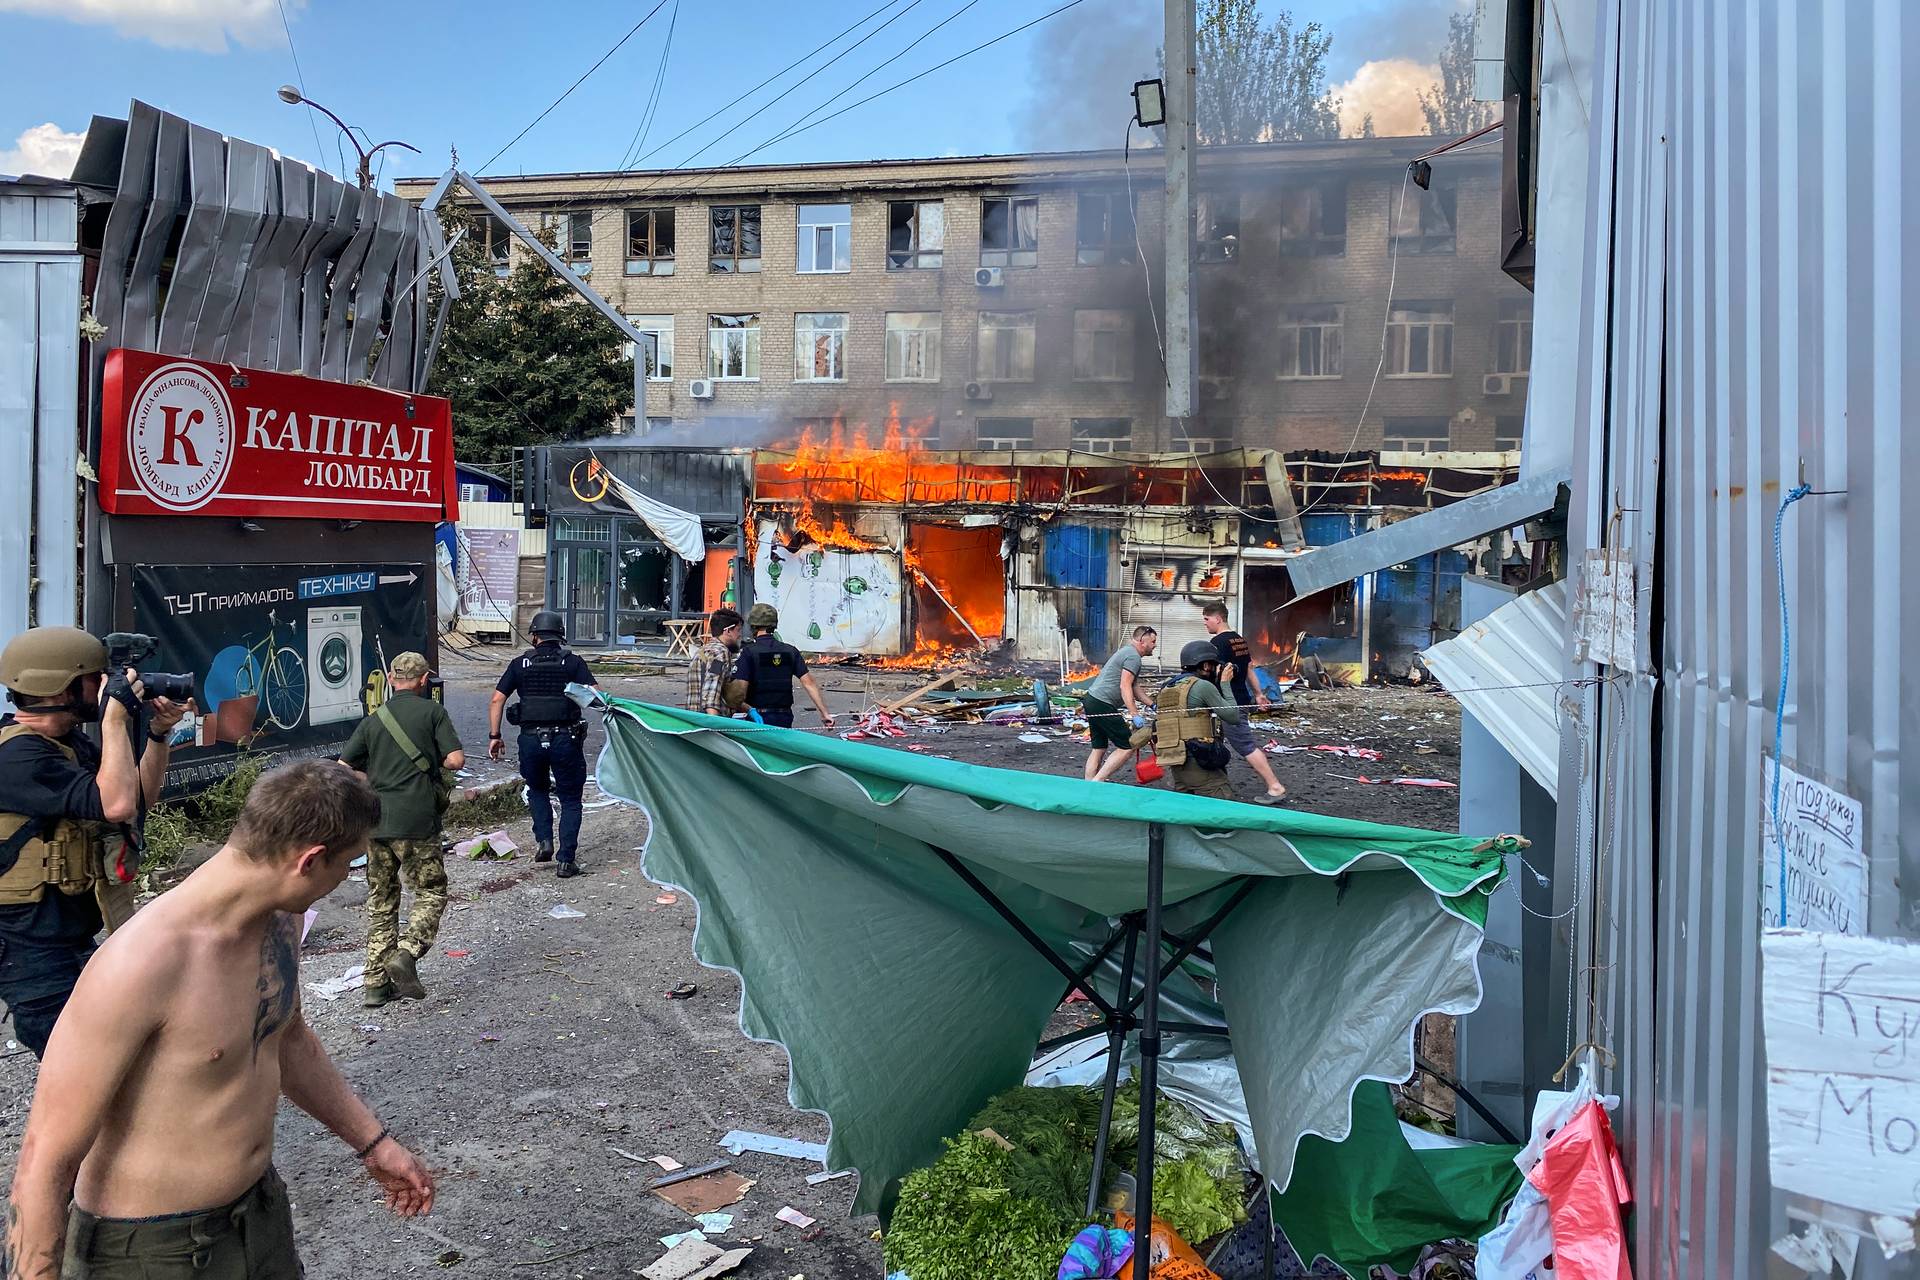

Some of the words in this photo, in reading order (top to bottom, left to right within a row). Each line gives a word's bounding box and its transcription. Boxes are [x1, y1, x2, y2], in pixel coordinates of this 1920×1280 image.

[140, 397, 155, 430] ВАША
[153, 377, 200, 398] ФІНАНСОВА
[200, 386, 224, 437] ДОПОМОГА
[241, 406, 434, 463] КАПІТАЛ
[156, 405, 204, 467] К
[138, 444, 180, 497] ЛОМБАРД
[186, 449, 223, 496] КАПІТАЛ
[303, 461, 432, 498] ЛОМБАРД
[163, 592, 208, 616] ТУТ
[208, 588, 295, 611] ПРИЙМАЮТЬ
